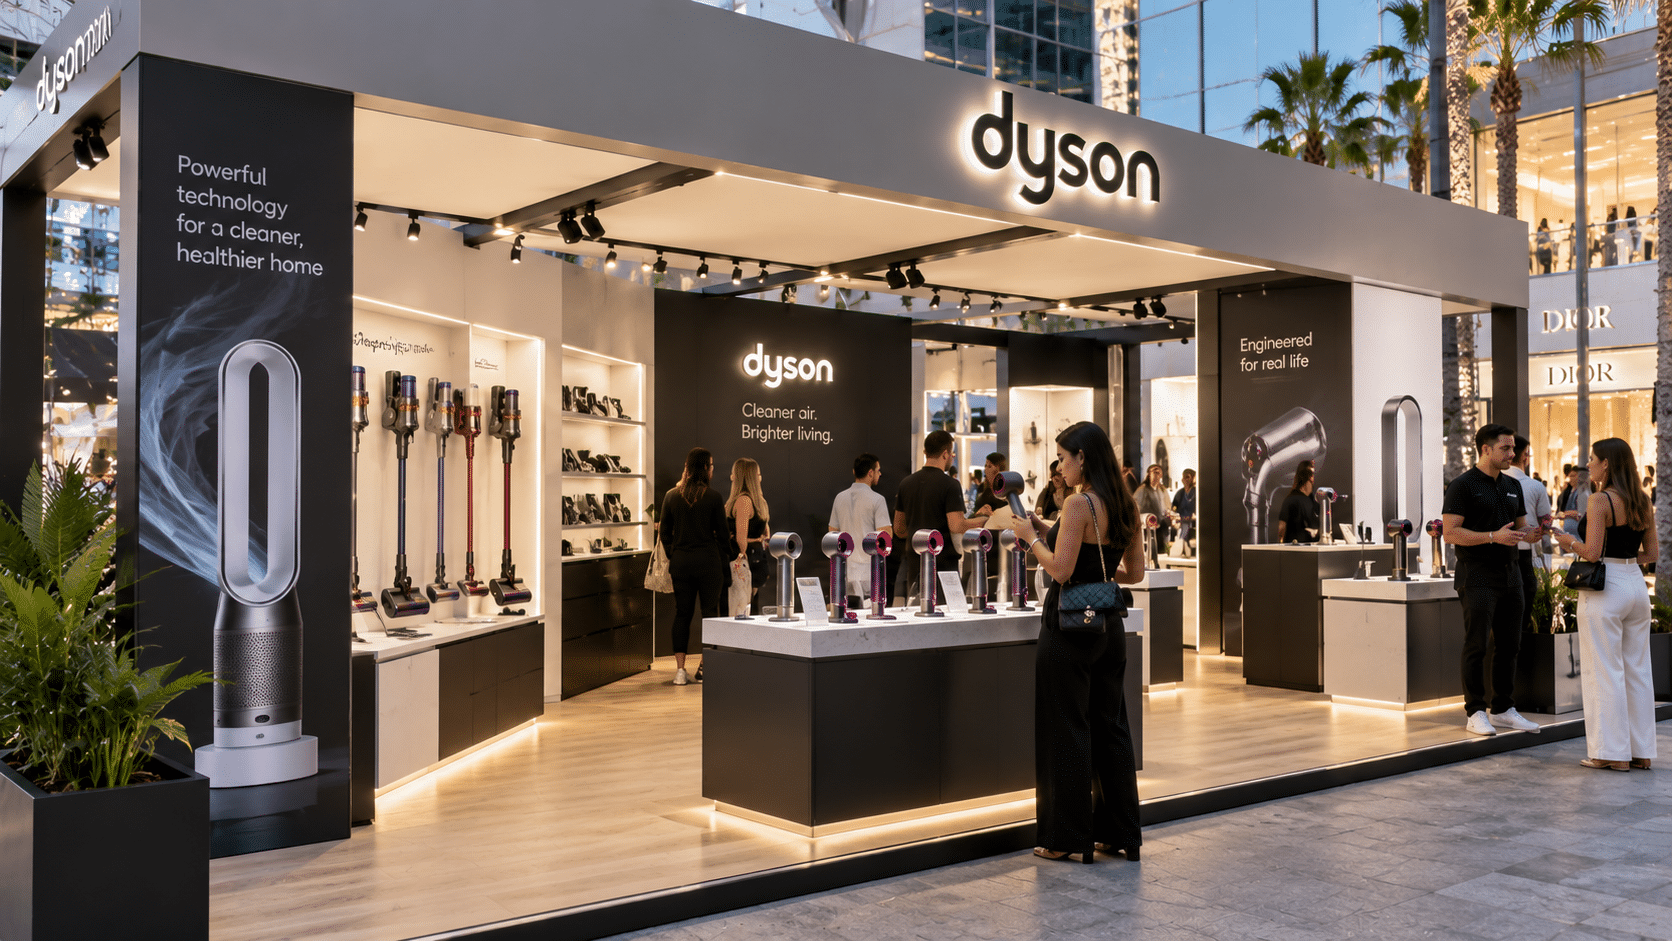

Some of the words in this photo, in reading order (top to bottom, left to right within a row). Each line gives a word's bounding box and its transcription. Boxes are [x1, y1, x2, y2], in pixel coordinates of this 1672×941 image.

[971, 89, 1161, 205] dyson
[178, 154, 267, 186] Powerful
[176, 185, 289, 221] technology
[176, 213, 206, 234] for
[211, 222, 224, 237] a
[229, 220, 304, 249] cleaner,
[177, 241, 265, 270] healthier
[270, 252, 324, 276] home
[1240, 331, 1313, 355] Engineered
[743, 342, 834, 389] dyson
[1240, 357, 1259, 372] for
[1262, 354, 1286, 370] real
[1289, 352, 1309, 368] life
[741, 402, 796, 420] Cleaner
[798, 405, 818, 421] air.
[741, 423, 795, 443] Brighter
[797, 425, 834, 445] living.
